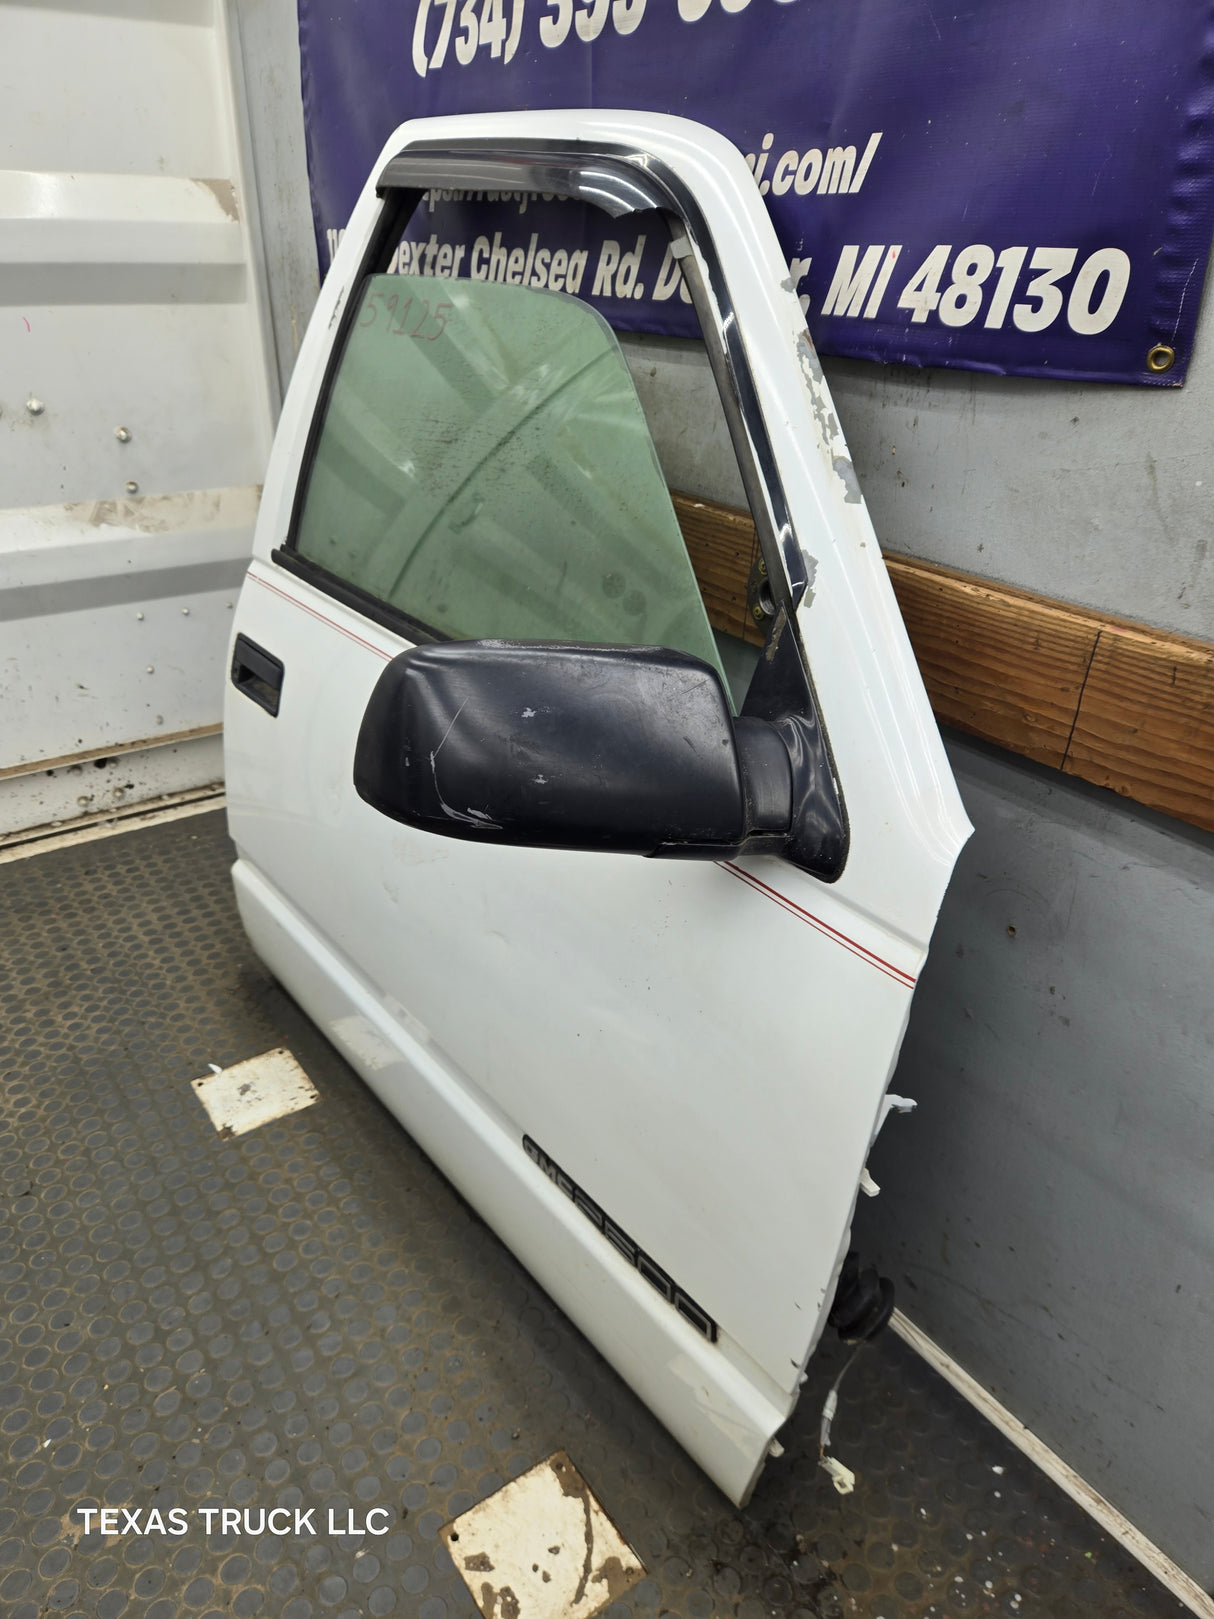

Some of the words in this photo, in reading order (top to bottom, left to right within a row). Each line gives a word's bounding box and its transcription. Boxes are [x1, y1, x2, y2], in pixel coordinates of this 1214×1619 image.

[471, 232, 588, 294] Chelsea
[591, 234, 647, 300] Rd.
[821, 245, 902, 320] MI
[897, 244, 1131, 336] 48130
